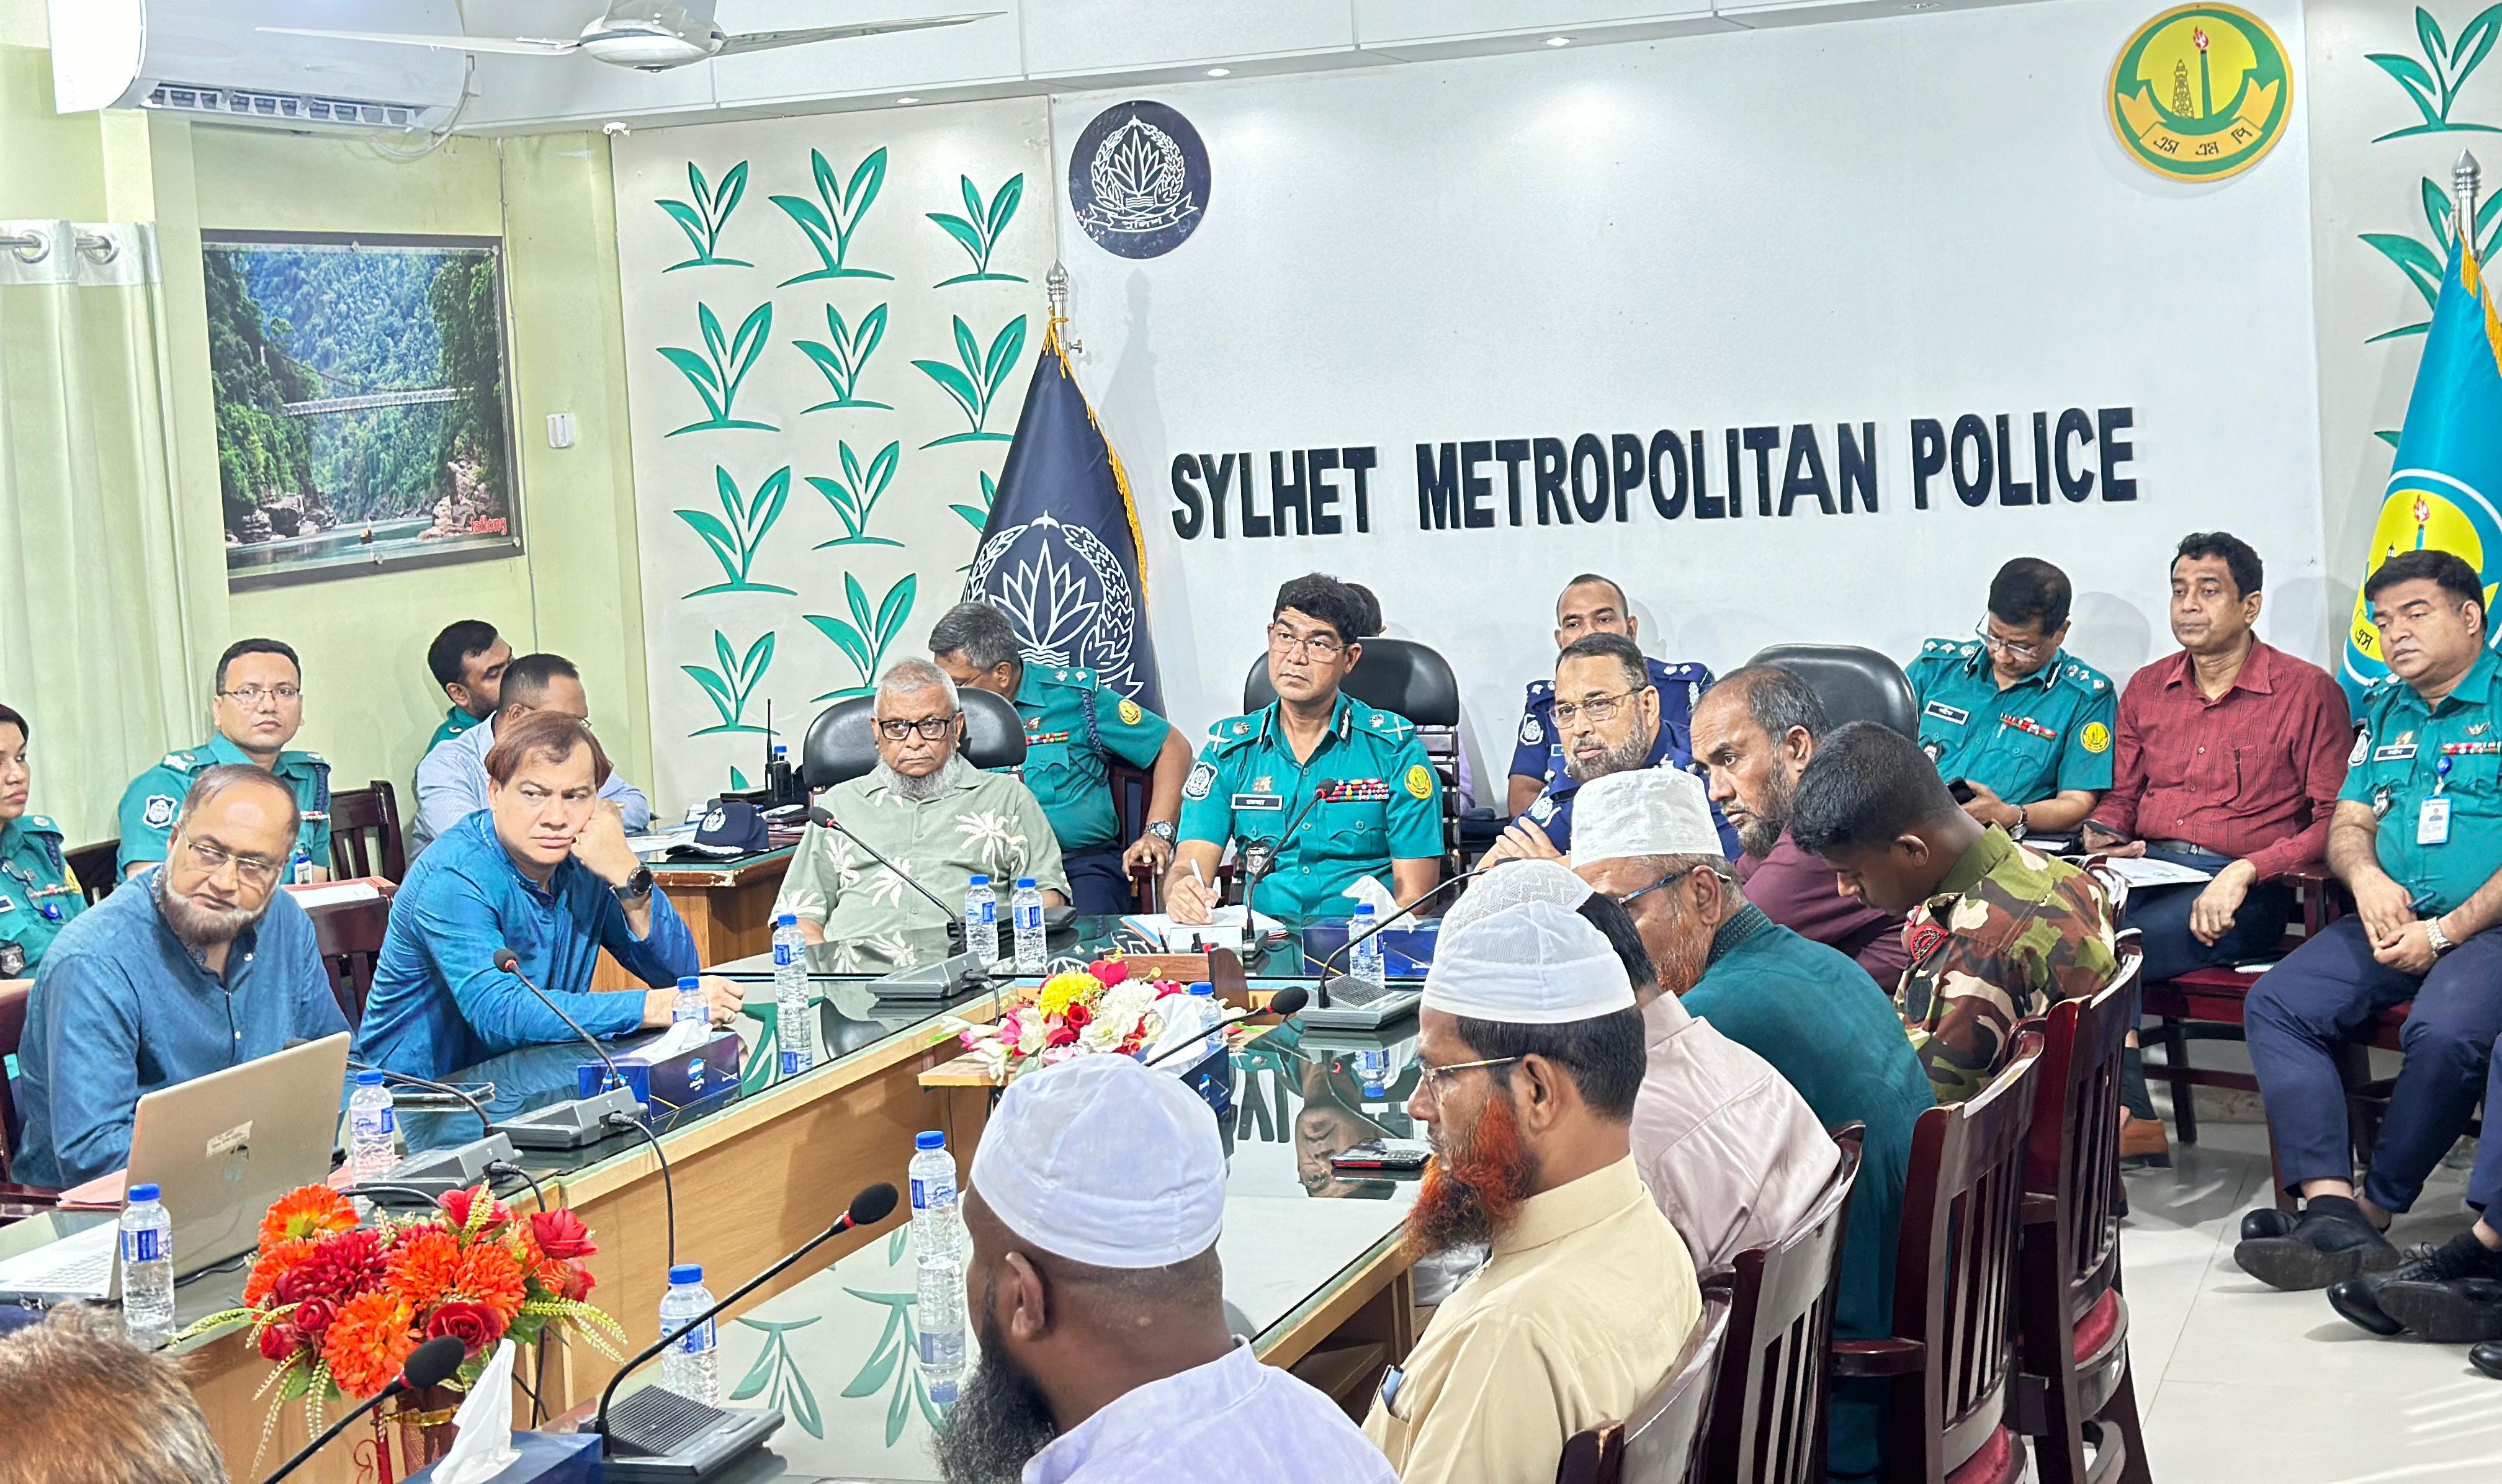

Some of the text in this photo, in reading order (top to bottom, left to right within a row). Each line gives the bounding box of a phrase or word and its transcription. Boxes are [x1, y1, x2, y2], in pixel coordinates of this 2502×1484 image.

[2153, 127, 2253, 156] এস এম পি
[1171, 407, 2138, 540] SYLHET METROPOLITAN POLICE
[2354, 628, 2374, 651] এস
